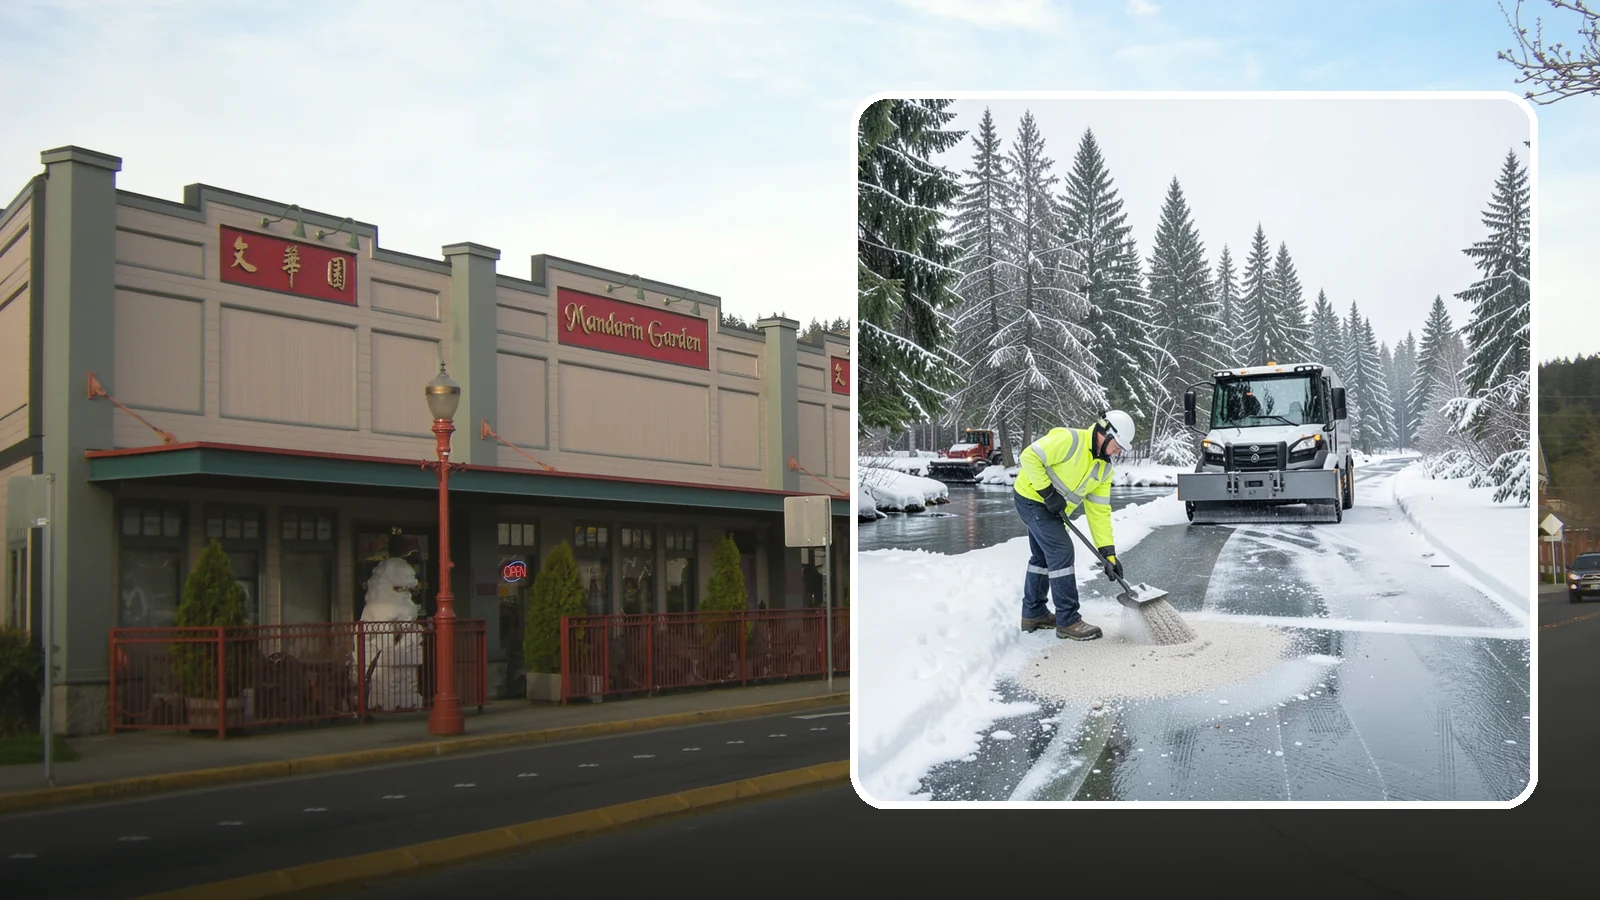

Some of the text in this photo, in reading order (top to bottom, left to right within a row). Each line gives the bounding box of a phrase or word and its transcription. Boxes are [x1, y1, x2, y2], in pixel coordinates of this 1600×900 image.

[231, 236, 346, 291] 文華園
[564, 302, 701, 352] Mandarin Garden
[503, 565, 527, 578] OPEN
